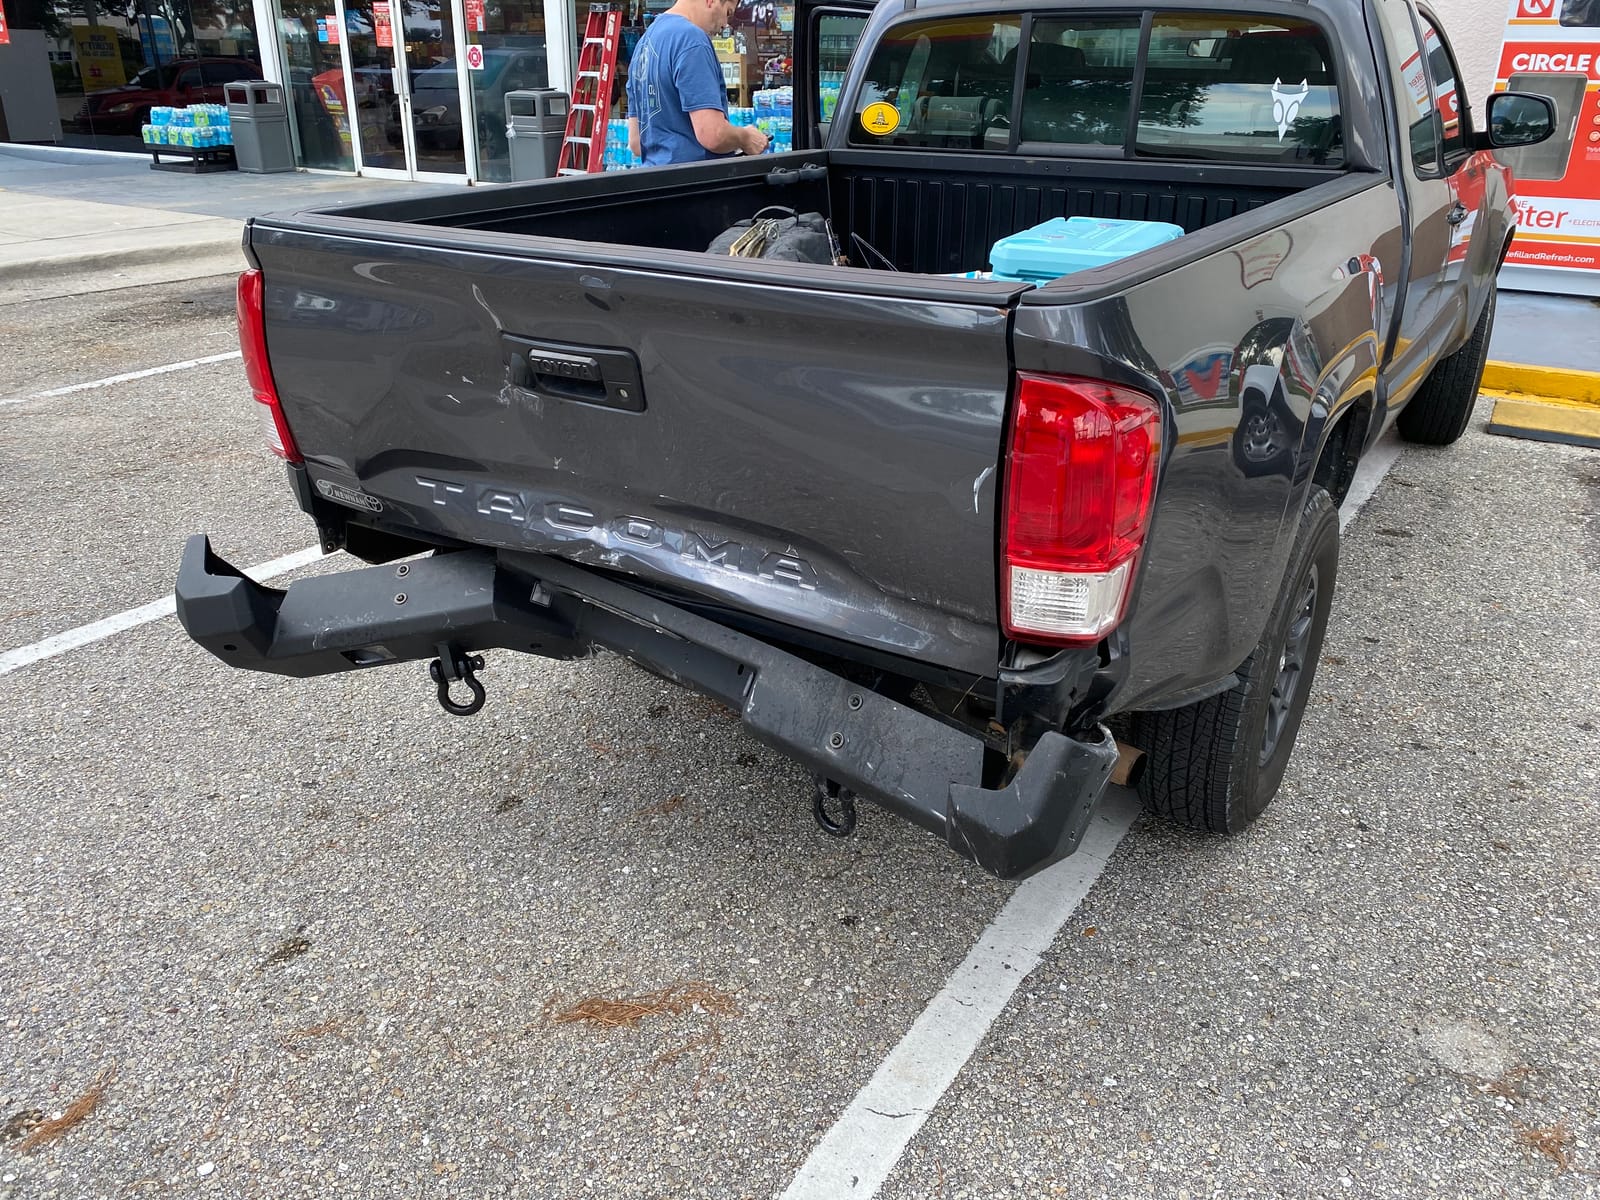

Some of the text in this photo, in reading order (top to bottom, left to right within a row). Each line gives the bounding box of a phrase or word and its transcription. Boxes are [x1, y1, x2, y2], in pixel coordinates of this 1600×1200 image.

[1511, 53, 1592, 72] CIRCLE
[531, 356, 593, 379] TOYOTA
[334, 489, 366, 506] NEWNAN
[414, 475, 819, 592] TACOMA
